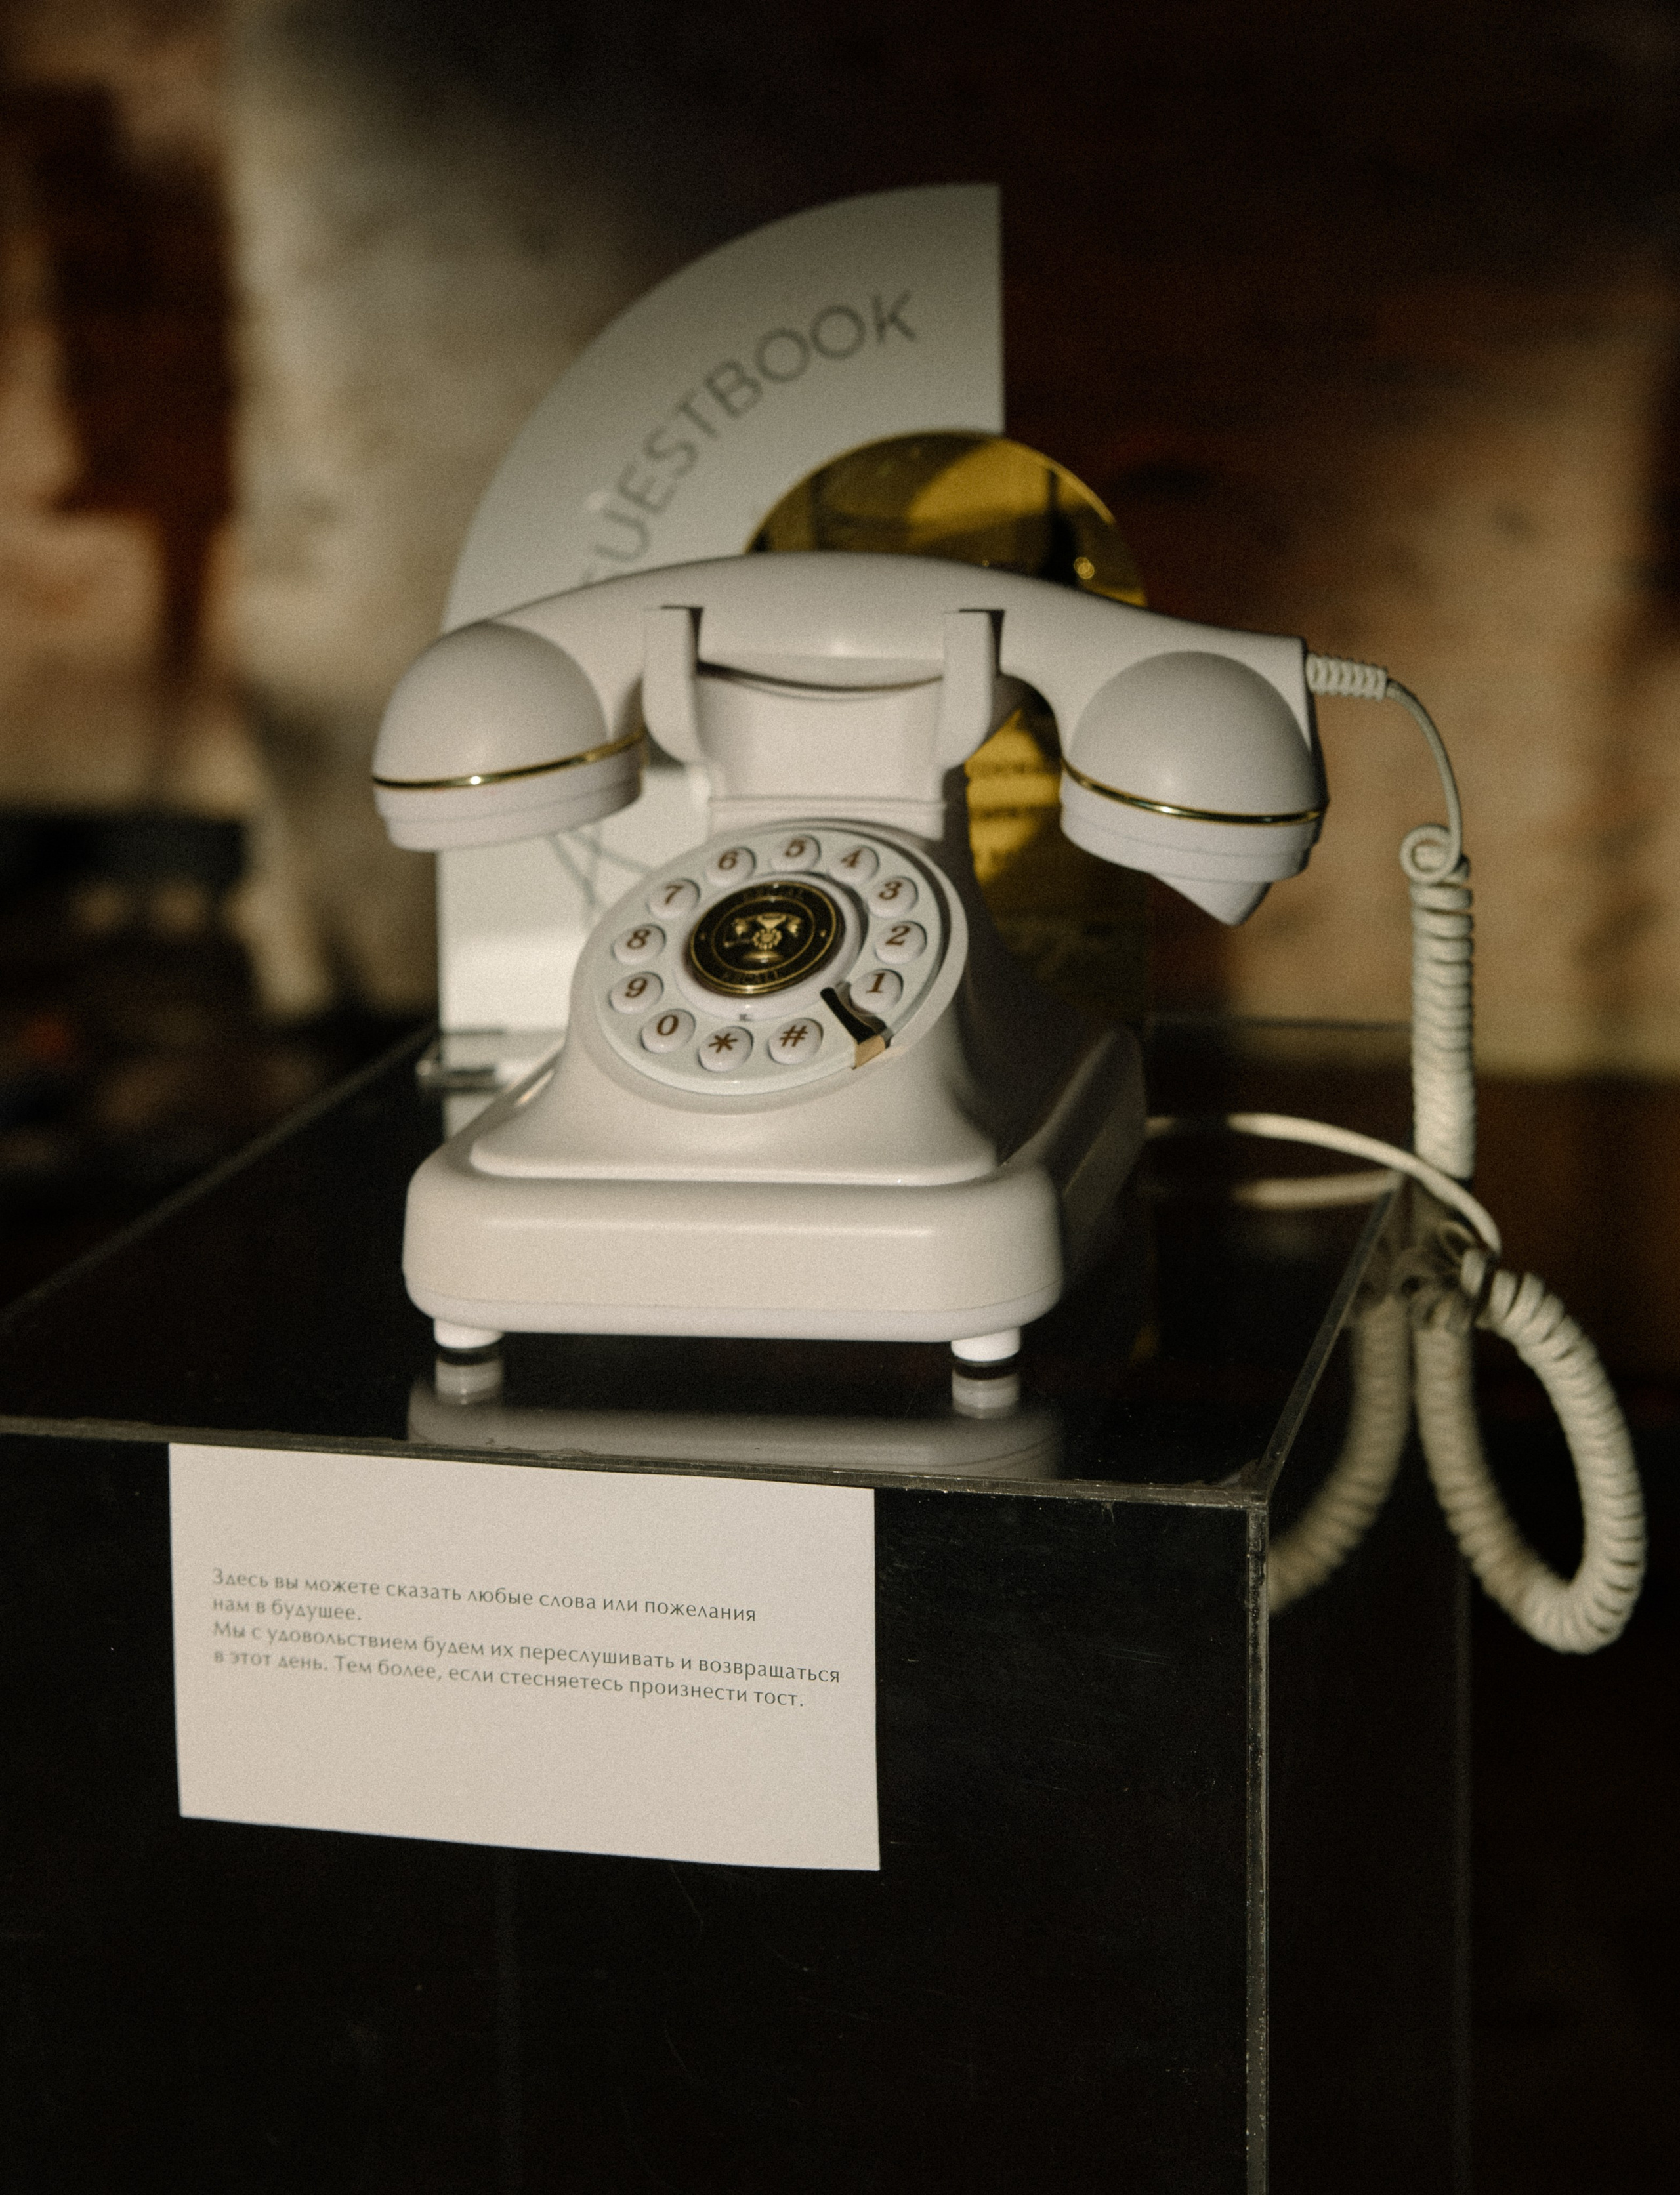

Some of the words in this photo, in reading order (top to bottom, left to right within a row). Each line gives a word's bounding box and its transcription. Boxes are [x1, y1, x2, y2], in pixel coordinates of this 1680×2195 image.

[588, 289, 916, 572] UESTBOOK
[785, 838, 807, 858] 5
[840, 848, 862, 869] 4
[717, 851, 739, 871] 6
[662, 883, 684, 906] 7
[878, 881, 902, 900] 3
[626, 928, 651, 950] 8
[885, 925, 911, 946] 2
[624, 977, 648, 999] 9
[866, 972, 886, 994] 1
[656, 1014, 679, 1037] 0
[212, 1567, 269, 1588] Здесь
[274, 1576, 299, 1590] вы
[304, 1579, 380, 1595] можете
[385, 1583, 462, 1601] сказать
[467, 1587, 534, 1606] любые
[538, 1594, 597, 1610] слова
[602, 1598, 638, 1612] или
[644, 1600, 756, 1622] пожелания
[213, 1599, 250, 1613] нам
[256, 1601, 266, 1614] в
[214, 1621, 245, 1639] Мы
[251, 1627, 262, 1639] с
[267, 1628, 418, 1650] удовольствием
[423, 1635, 484, 1658] будем
[490, 1644, 514, 1658] их
[520, 1646, 675, 1669] переслушивать
[681, 1658, 692, 1670] и
[698, 1659, 840, 1683] возвращаться
[214, 1650, 224, 1663] в
[230, 1652, 270, 1666] этот
[278, 1656, 328, 1671] день.
[333, 1654, 372, 1674] Тем
[377, 1659, 442, 1681] более,
[448, 1668, 494, 1683] если
[499, 1671, 623, 1692] стесняетесь
[629, 1680, 747, 1702] произнести
[753, 1691, 804, 1707] тост.
